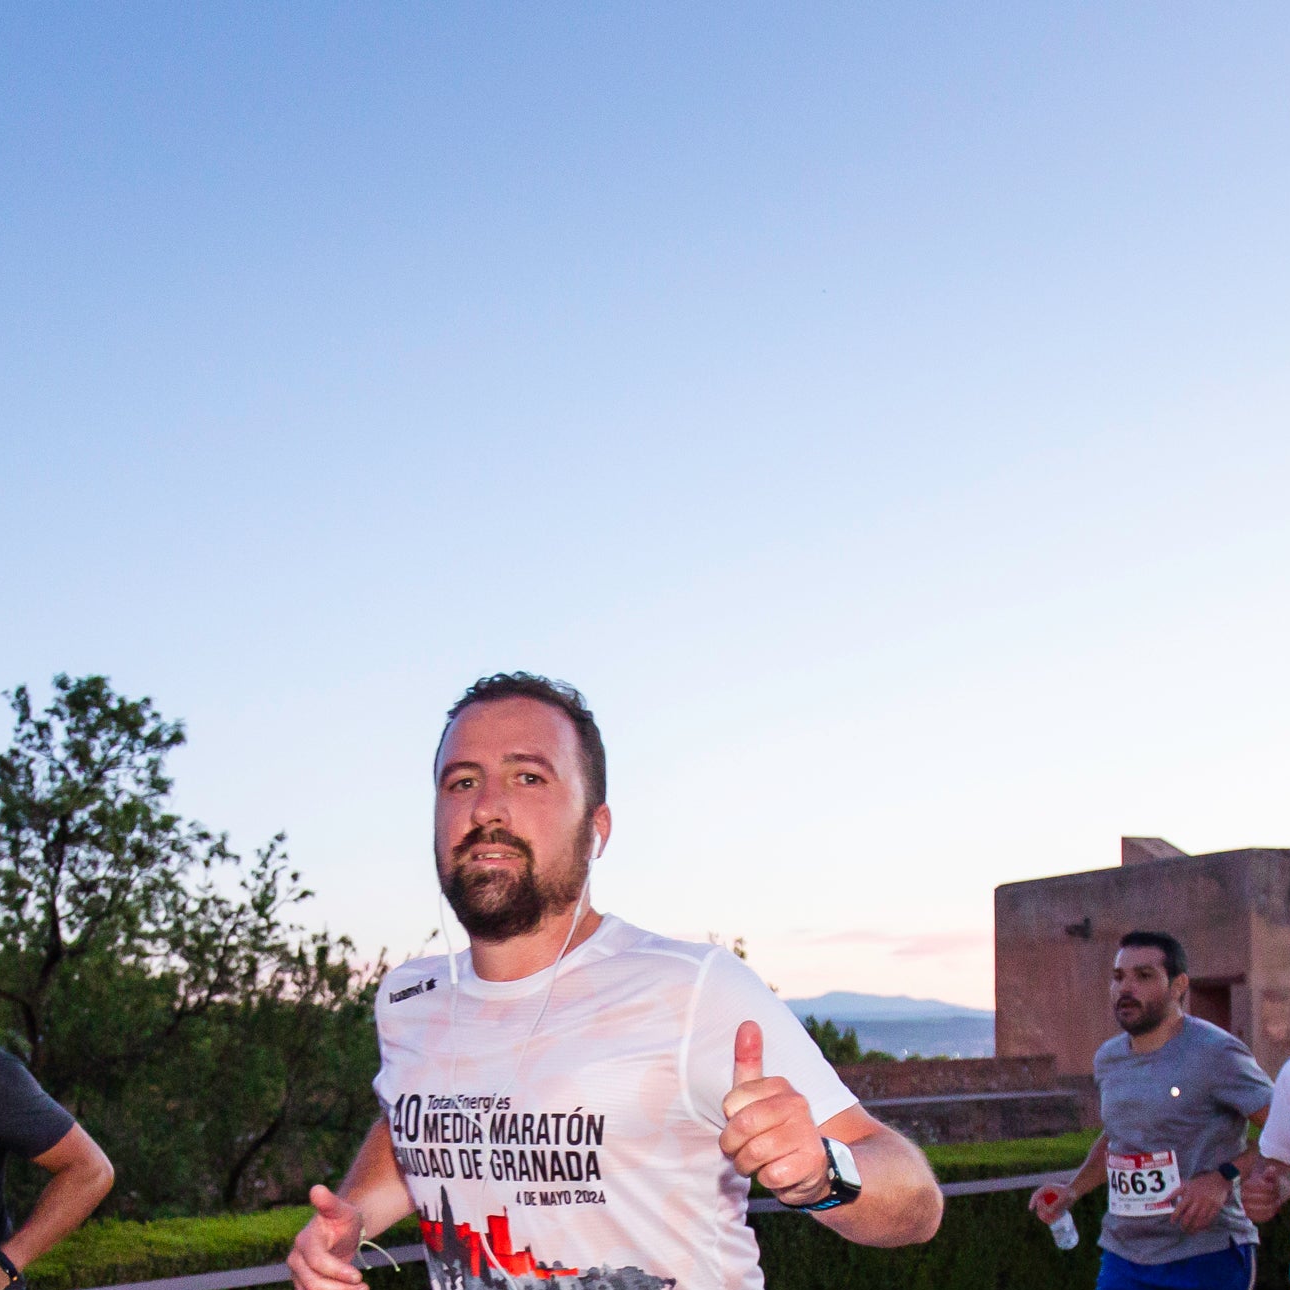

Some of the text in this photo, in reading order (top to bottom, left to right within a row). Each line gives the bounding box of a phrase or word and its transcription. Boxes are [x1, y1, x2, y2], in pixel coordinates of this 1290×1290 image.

[426, 1093, 511, 1114] TotaEnergies
[393, 1093, 605, 1146] 40 MEDIA MARATÓN
[459, 1148, 484, 1180] DE
[490, 1149, 602, 1183] GRANADA
[1111, 1170, 1167, 1195] 4663
[524, 1191, 537, 1206] DE
[540, 1190, 572, 1206] MAYO
[574, 1189, 607, 1205] 2024
